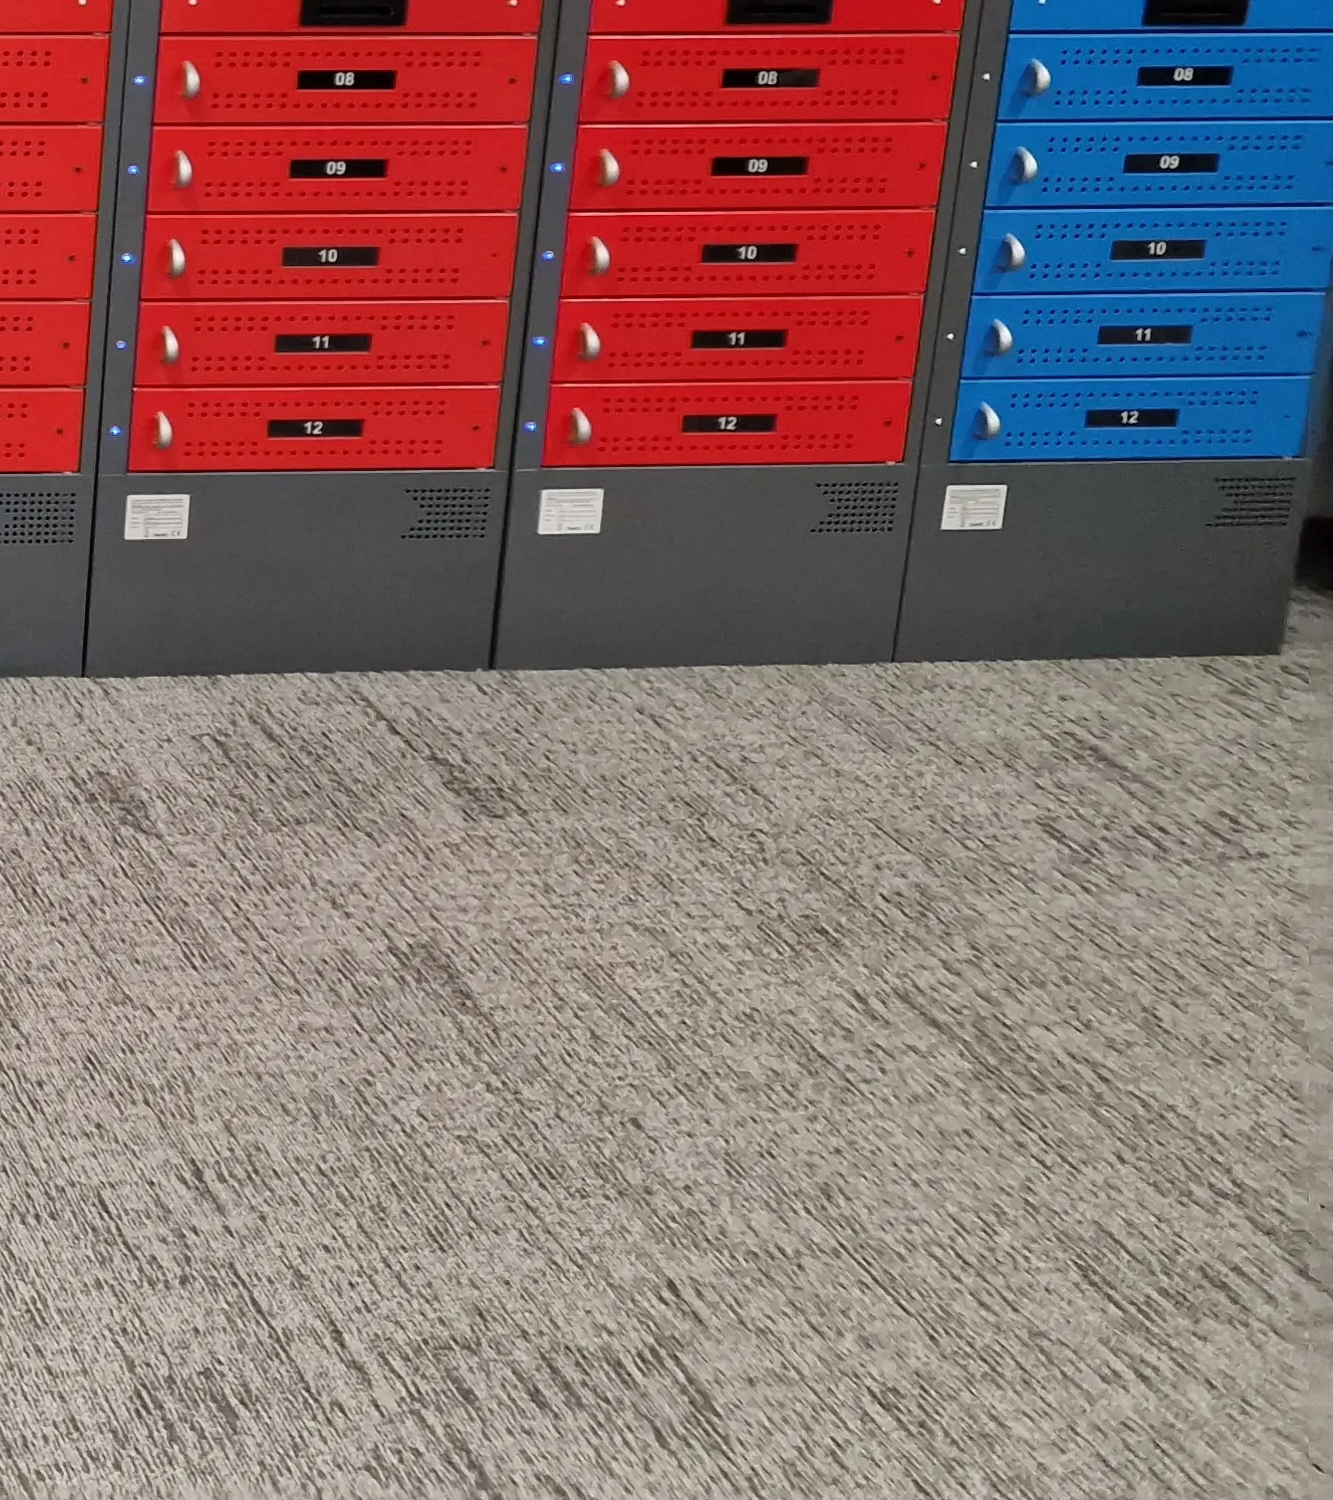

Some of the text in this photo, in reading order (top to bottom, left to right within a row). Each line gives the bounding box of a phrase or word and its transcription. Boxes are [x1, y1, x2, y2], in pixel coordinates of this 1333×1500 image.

[335, 71, 355, 86] 08
[757, 70, 778, 85] 08
[1173, 67, 1194, 82] 08
[326, 161, 347, 175] 09
[747, 158, 768, 173] 09
[1159, 155, 1180, 170] 09
[318, 248, 338, 263] 10
[737, 245, 758, 260] 10
[1147, 241, 1167, 256] 10
[312, 335, 330, 349] 11
[728, 331, 746, 346] 11
[1135, 328, 1152, 342] 11
[718, 416, 737, 430] 12
[1120, 410, 1139, 424] 12
[304, 421, 324, 435] 12
